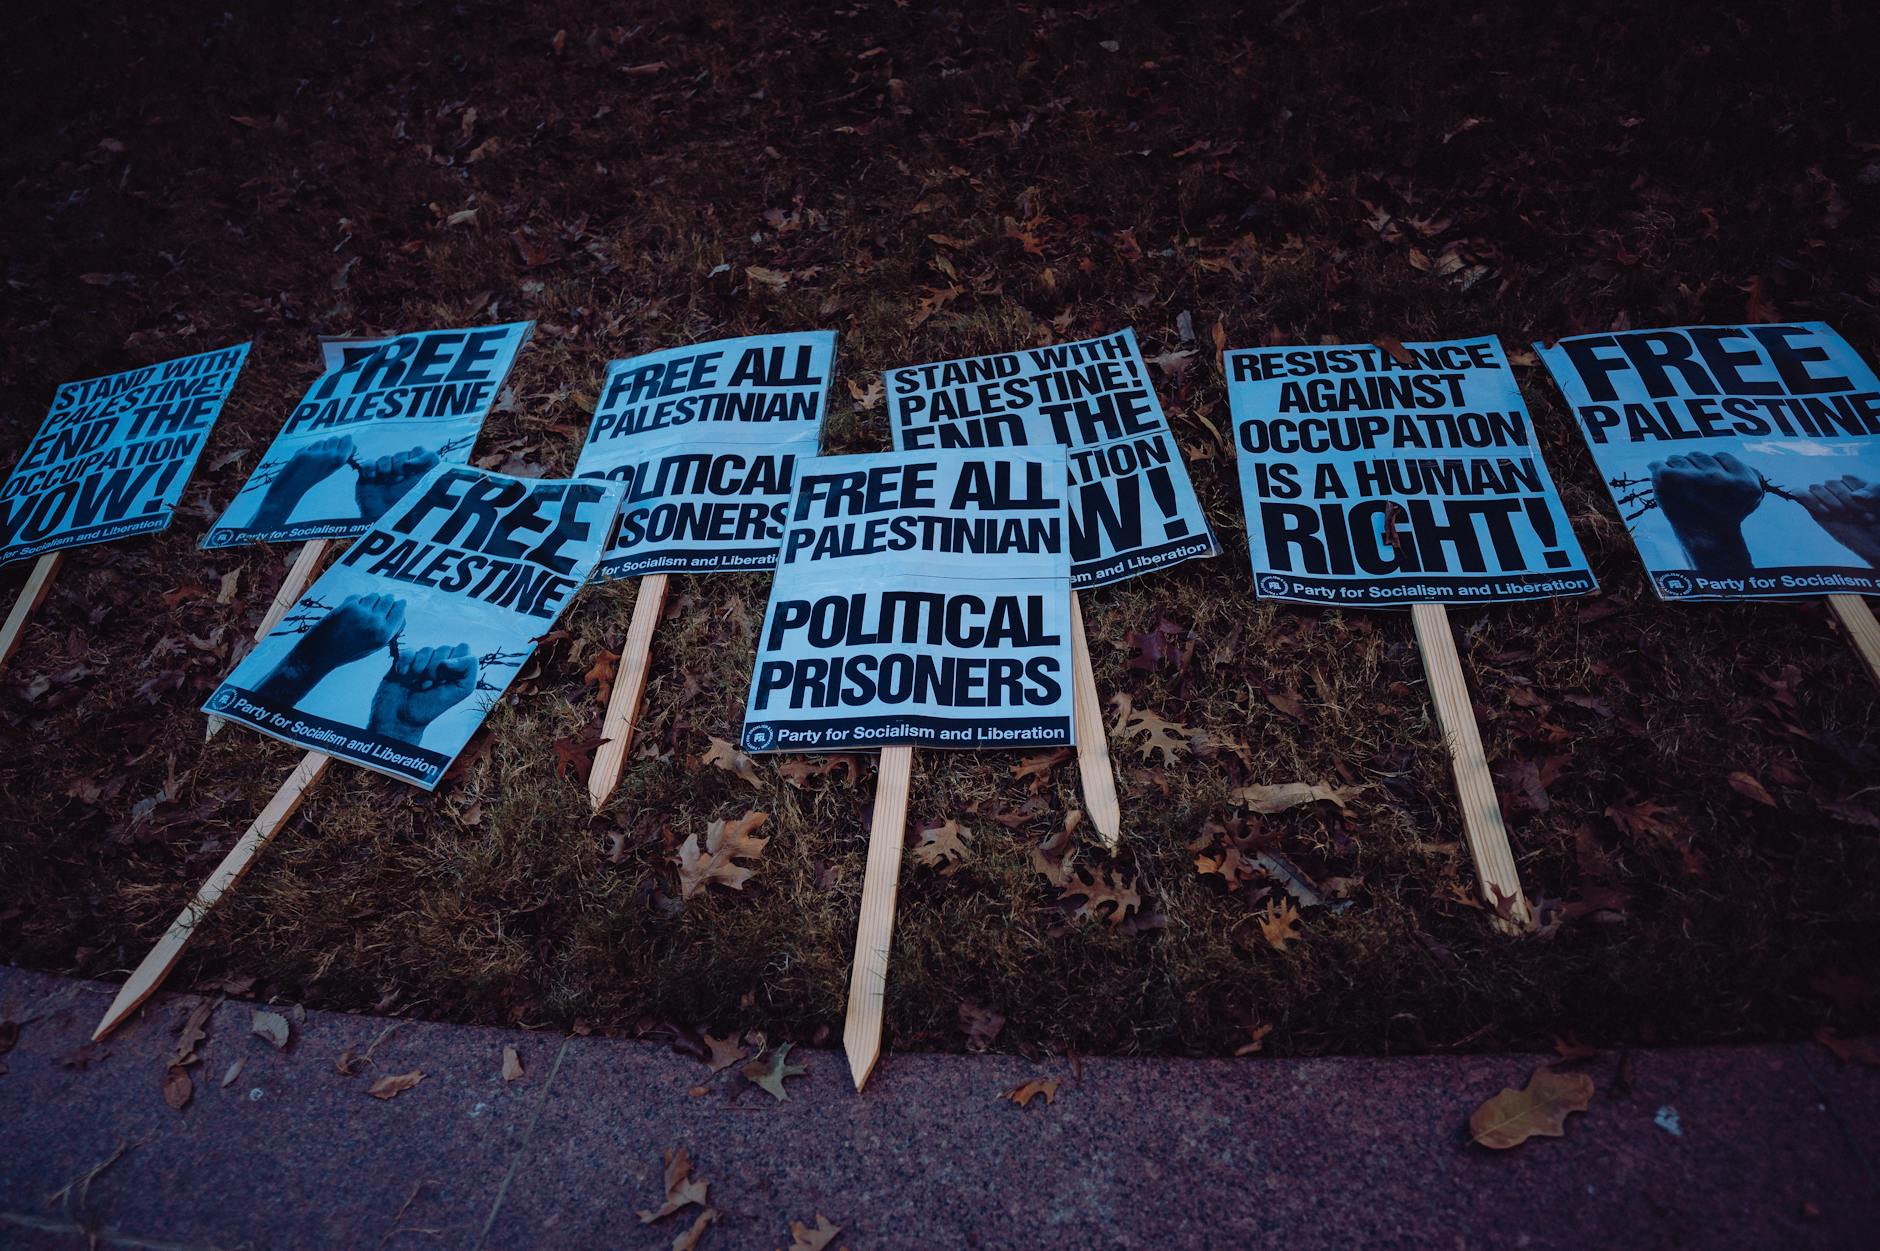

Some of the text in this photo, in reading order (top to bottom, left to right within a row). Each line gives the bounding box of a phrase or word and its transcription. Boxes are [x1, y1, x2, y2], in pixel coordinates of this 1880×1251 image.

[55, 352, 241, 411] STAND WITH
[314, 328, 509, 400] FREE
[602, 345, 822, 410] FREE ALL
[894, 335, 1132, 395] STAND WITH
[1232, 343, 1501, 382] RESISTANCE
[1560, 326, 1856, 402] FREE
[39, 371, 231, 438] PALESTINE!
[285, 381, 495, 434] PALESTINE
[588, 391, 822, 444] PALESTINIAN
[899, 360, 1143, 426] PALESTINE!
[902, 389, 1160, 450] END THE
[1279, 374, 1466, 413] AGAINST
[1578, 391, 1880, 444] PALESTINE
[18, 395, 221, 473] END THE
[1239, 411, 1529, 454] OCCUPATION
[1, 433, 201, 499] OCCUPATION
[793, 463, 938, 522] FREE
[950, 461, 1060, 510] ALL
[1254, 458, 1545, 499] IS A HUMAN
[3, 519, 162, 560] for Socialism and Liberation
[270, 530, 287, 539] for
[289, 524, 347, 537] Socialism
[350, 522, 374, 532] and
[392, 467, 606, 576] FREE
[605, 501, 789, 551] ISONERS
[784, 515, 1061, 564] PALESTINIAN
[1260, 497, 1572, 575] RIGHT!
[341, 529, 579, 619] PALESTINE
[601, 566, 620, 577] for
[622, 556, 687, 572] Socialism
[691, 556, 718, 567] and
[721, 554, 779, 566] Liberati
[1096, 562, 1125, 579] and
[1127, 543, 1207, 569] Liberation
[1293, 583, 1336, 599] Party
[1340, 586, 1364, 598] for
[1369, 584, 1453, 597] Socialism
[1454, 584, 1491, 596] and
[1495, 579, 1589, 595] Liberation
[1696, 578, 1745, 591] Party
[1749, 577, 1776, 588] for
[1780, 574, 1872, 587] Socialism
[766, 591, 1061, 652] POLITICAL
[754, 653, 1062, 711] PRISONERS
[233, 698, 271, 721] Party
[269, 713, 292, 729] for
[291, 720, 347, 747] Socialism
[347, 739, 374, 754] and
[371, 745, 439, 776] Liberation
[778, 729, 821, 744] Party
[825, 728, 850, 741] for
[853, 724, 934, 740] Socialism
[940, 728, 972, 740] and
[977, 727, 1065, 740] Liberation
